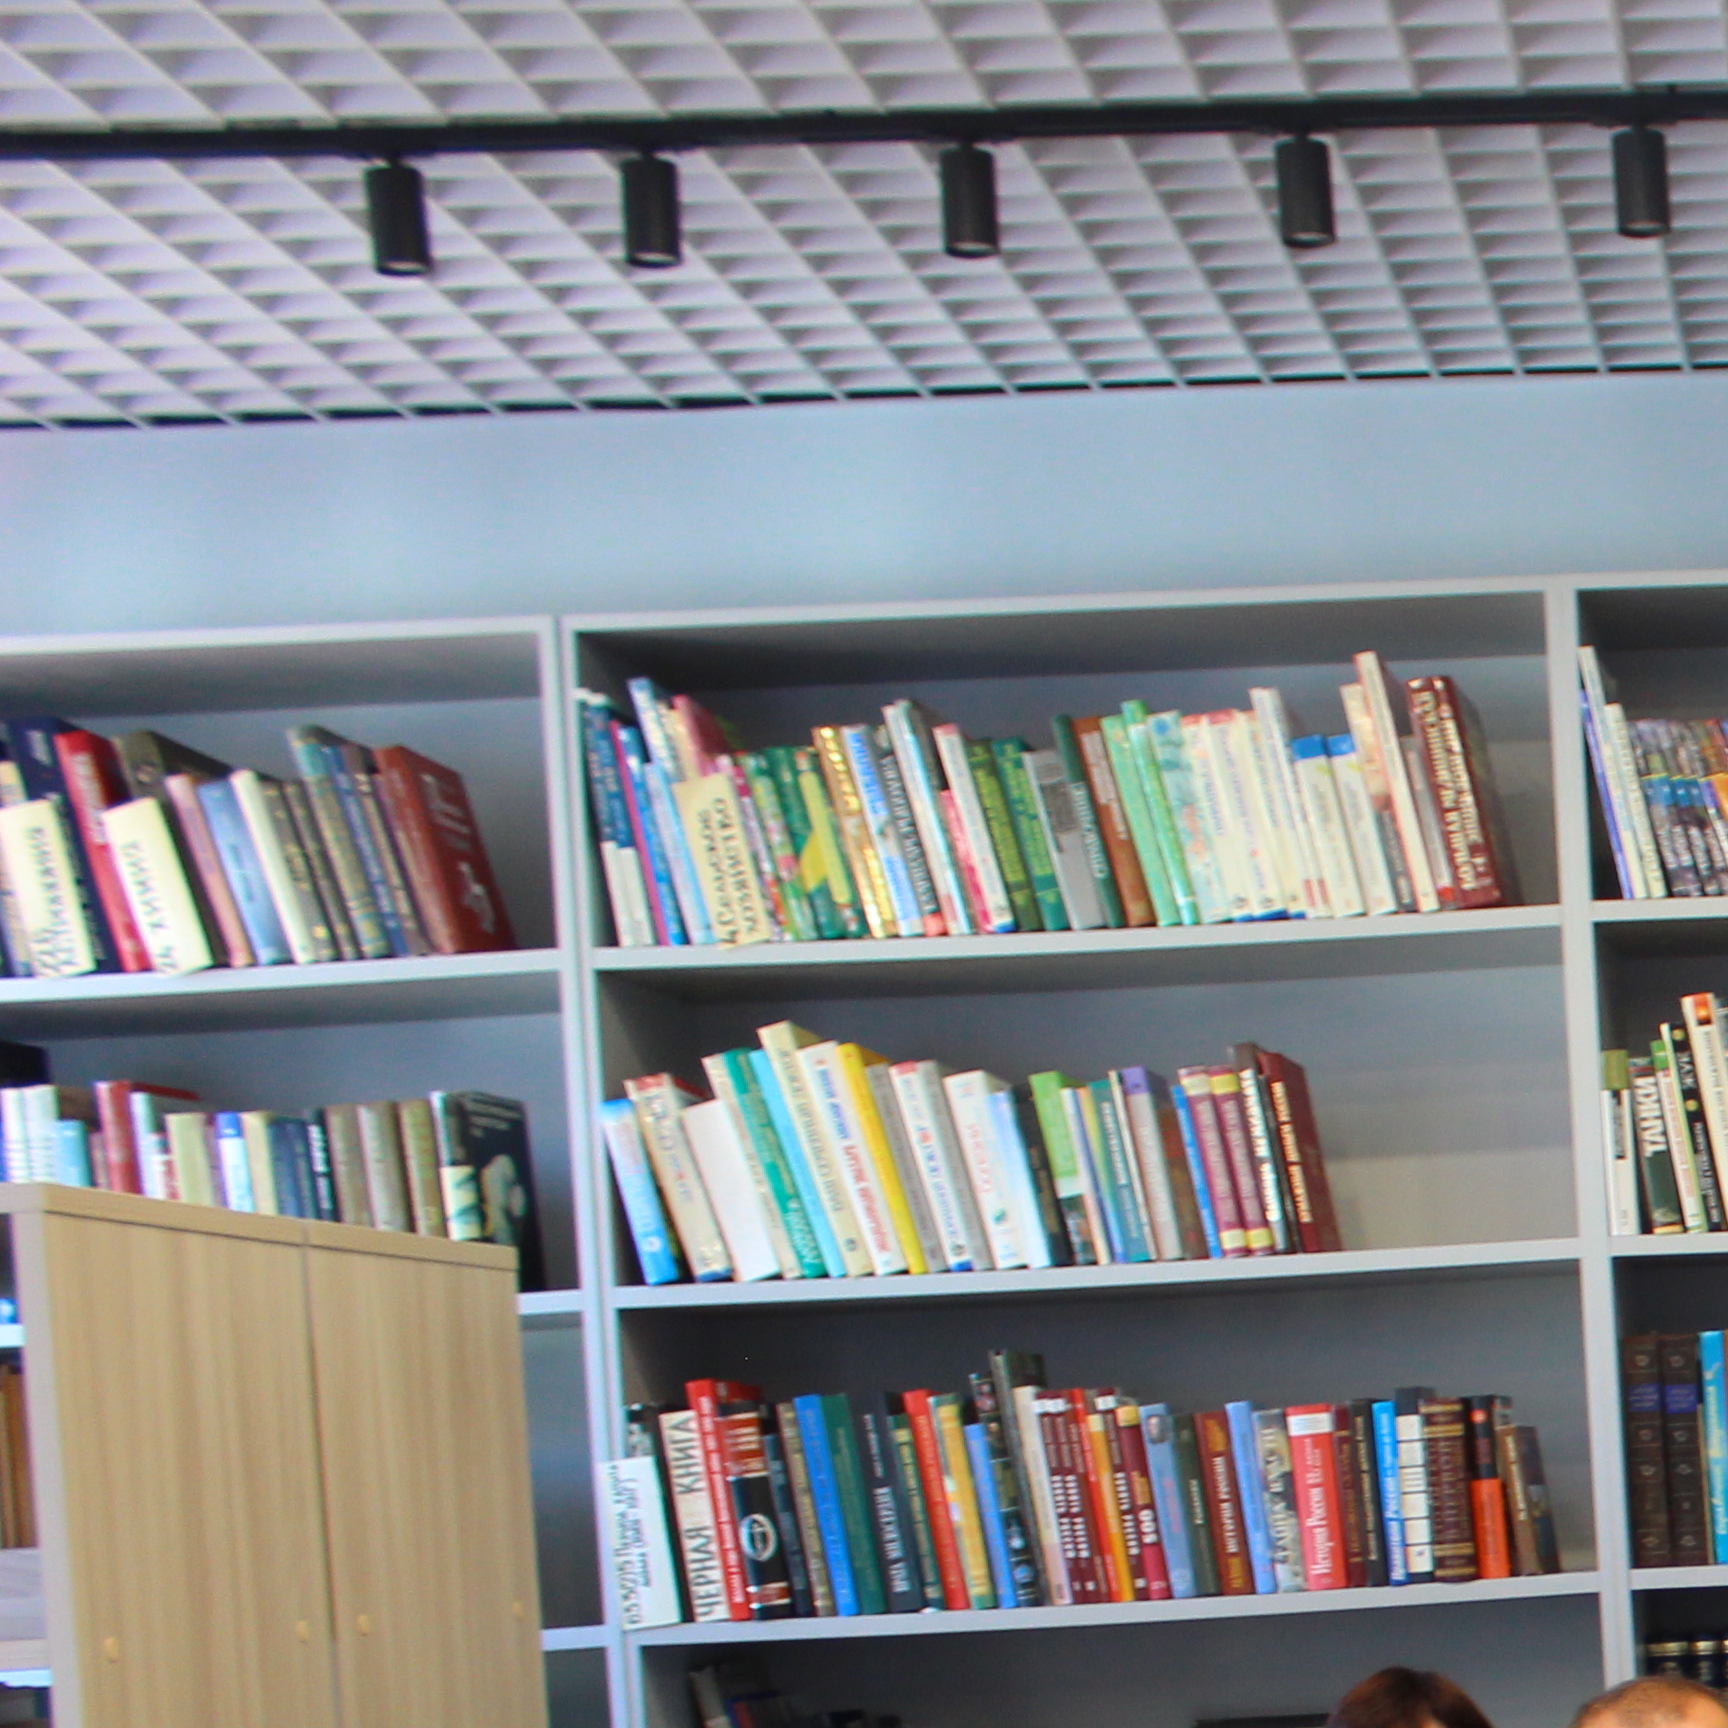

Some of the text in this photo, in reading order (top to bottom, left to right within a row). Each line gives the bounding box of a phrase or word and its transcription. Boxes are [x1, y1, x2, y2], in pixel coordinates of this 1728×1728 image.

[1632, 1075, 1667, 1156] ТАНКИ
[664, 1415, 724, 1616] ЧЕРНАЯ КНИГА
[1306, 1487, 1327, 1526] России
[1309, 1526, 1335, 1575] История
